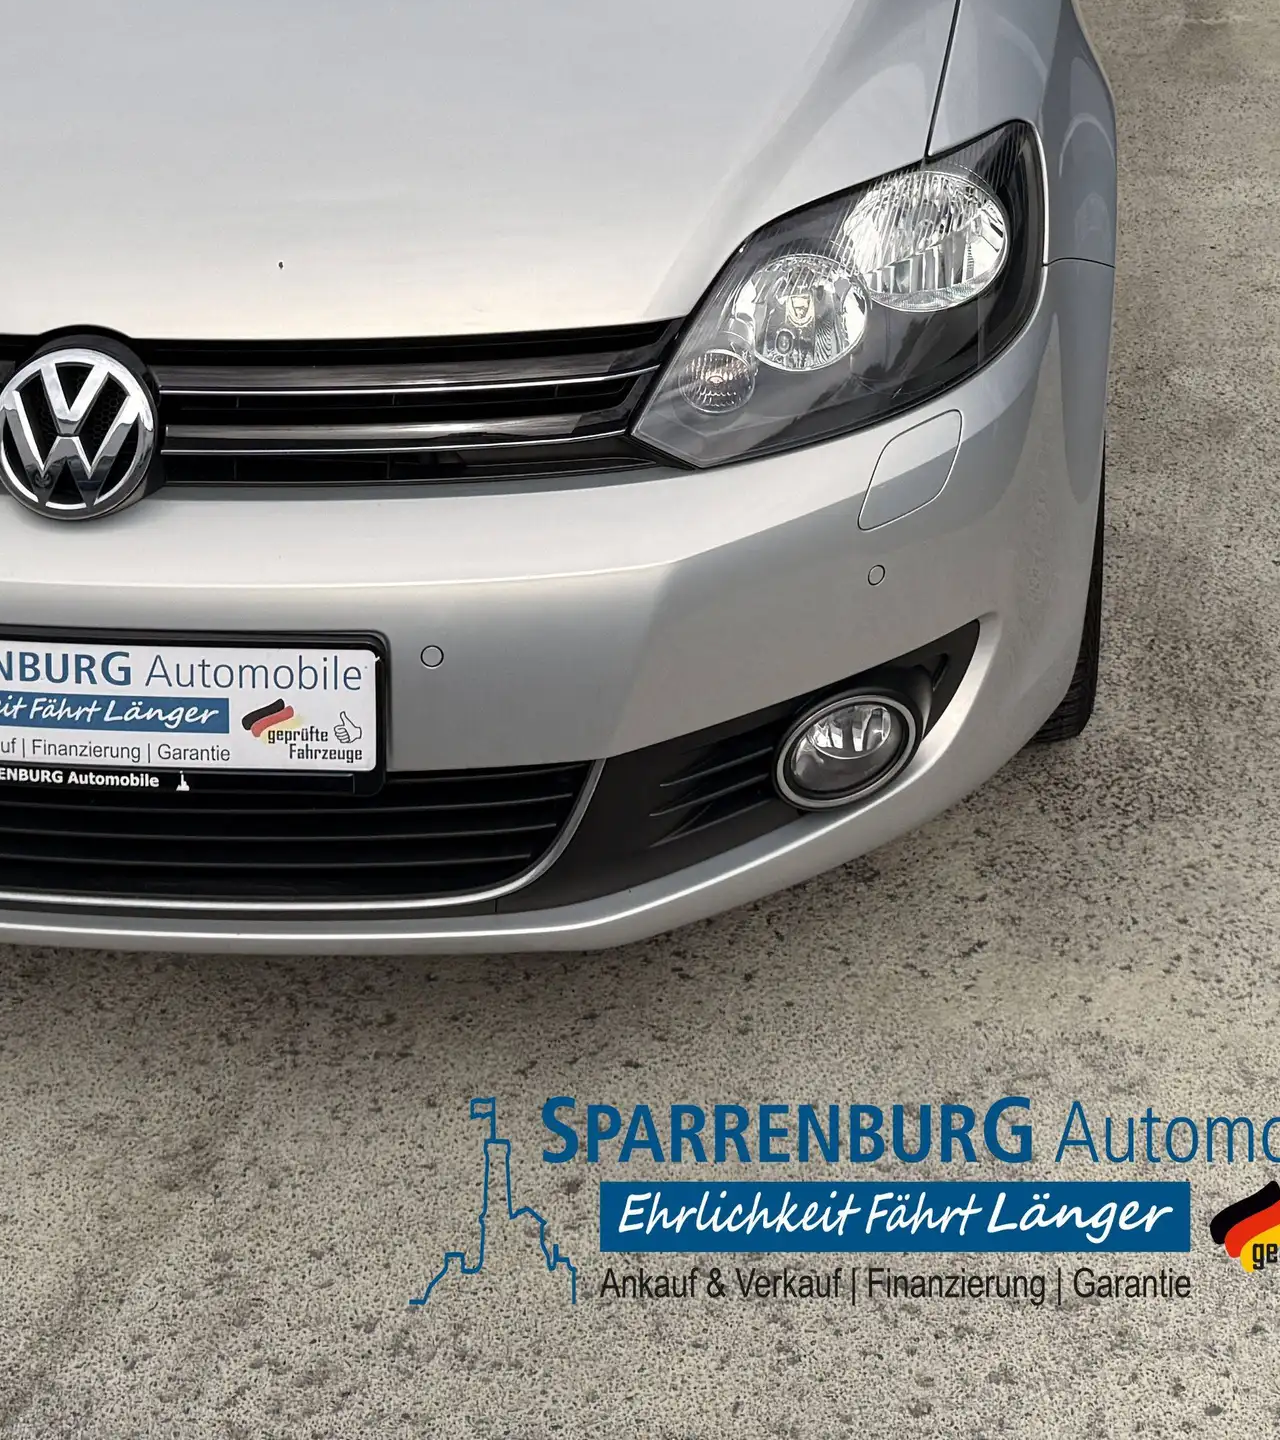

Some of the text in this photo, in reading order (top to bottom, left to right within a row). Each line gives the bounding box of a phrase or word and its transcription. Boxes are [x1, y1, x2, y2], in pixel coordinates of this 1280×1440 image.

[145, 654, 362, 691] Automobile
[29, 698, 101, 722] Fährt
[104, 700, 218, 729] Länger
[268, 726, 328, 745] geprüfte
[32, 739, 141, 763] Finanzierung
[158, 744, 230, 761] Garantie
[289, 744, 362, 763] Fahrzeuge
[67, 771, 159, 788] Automobile
